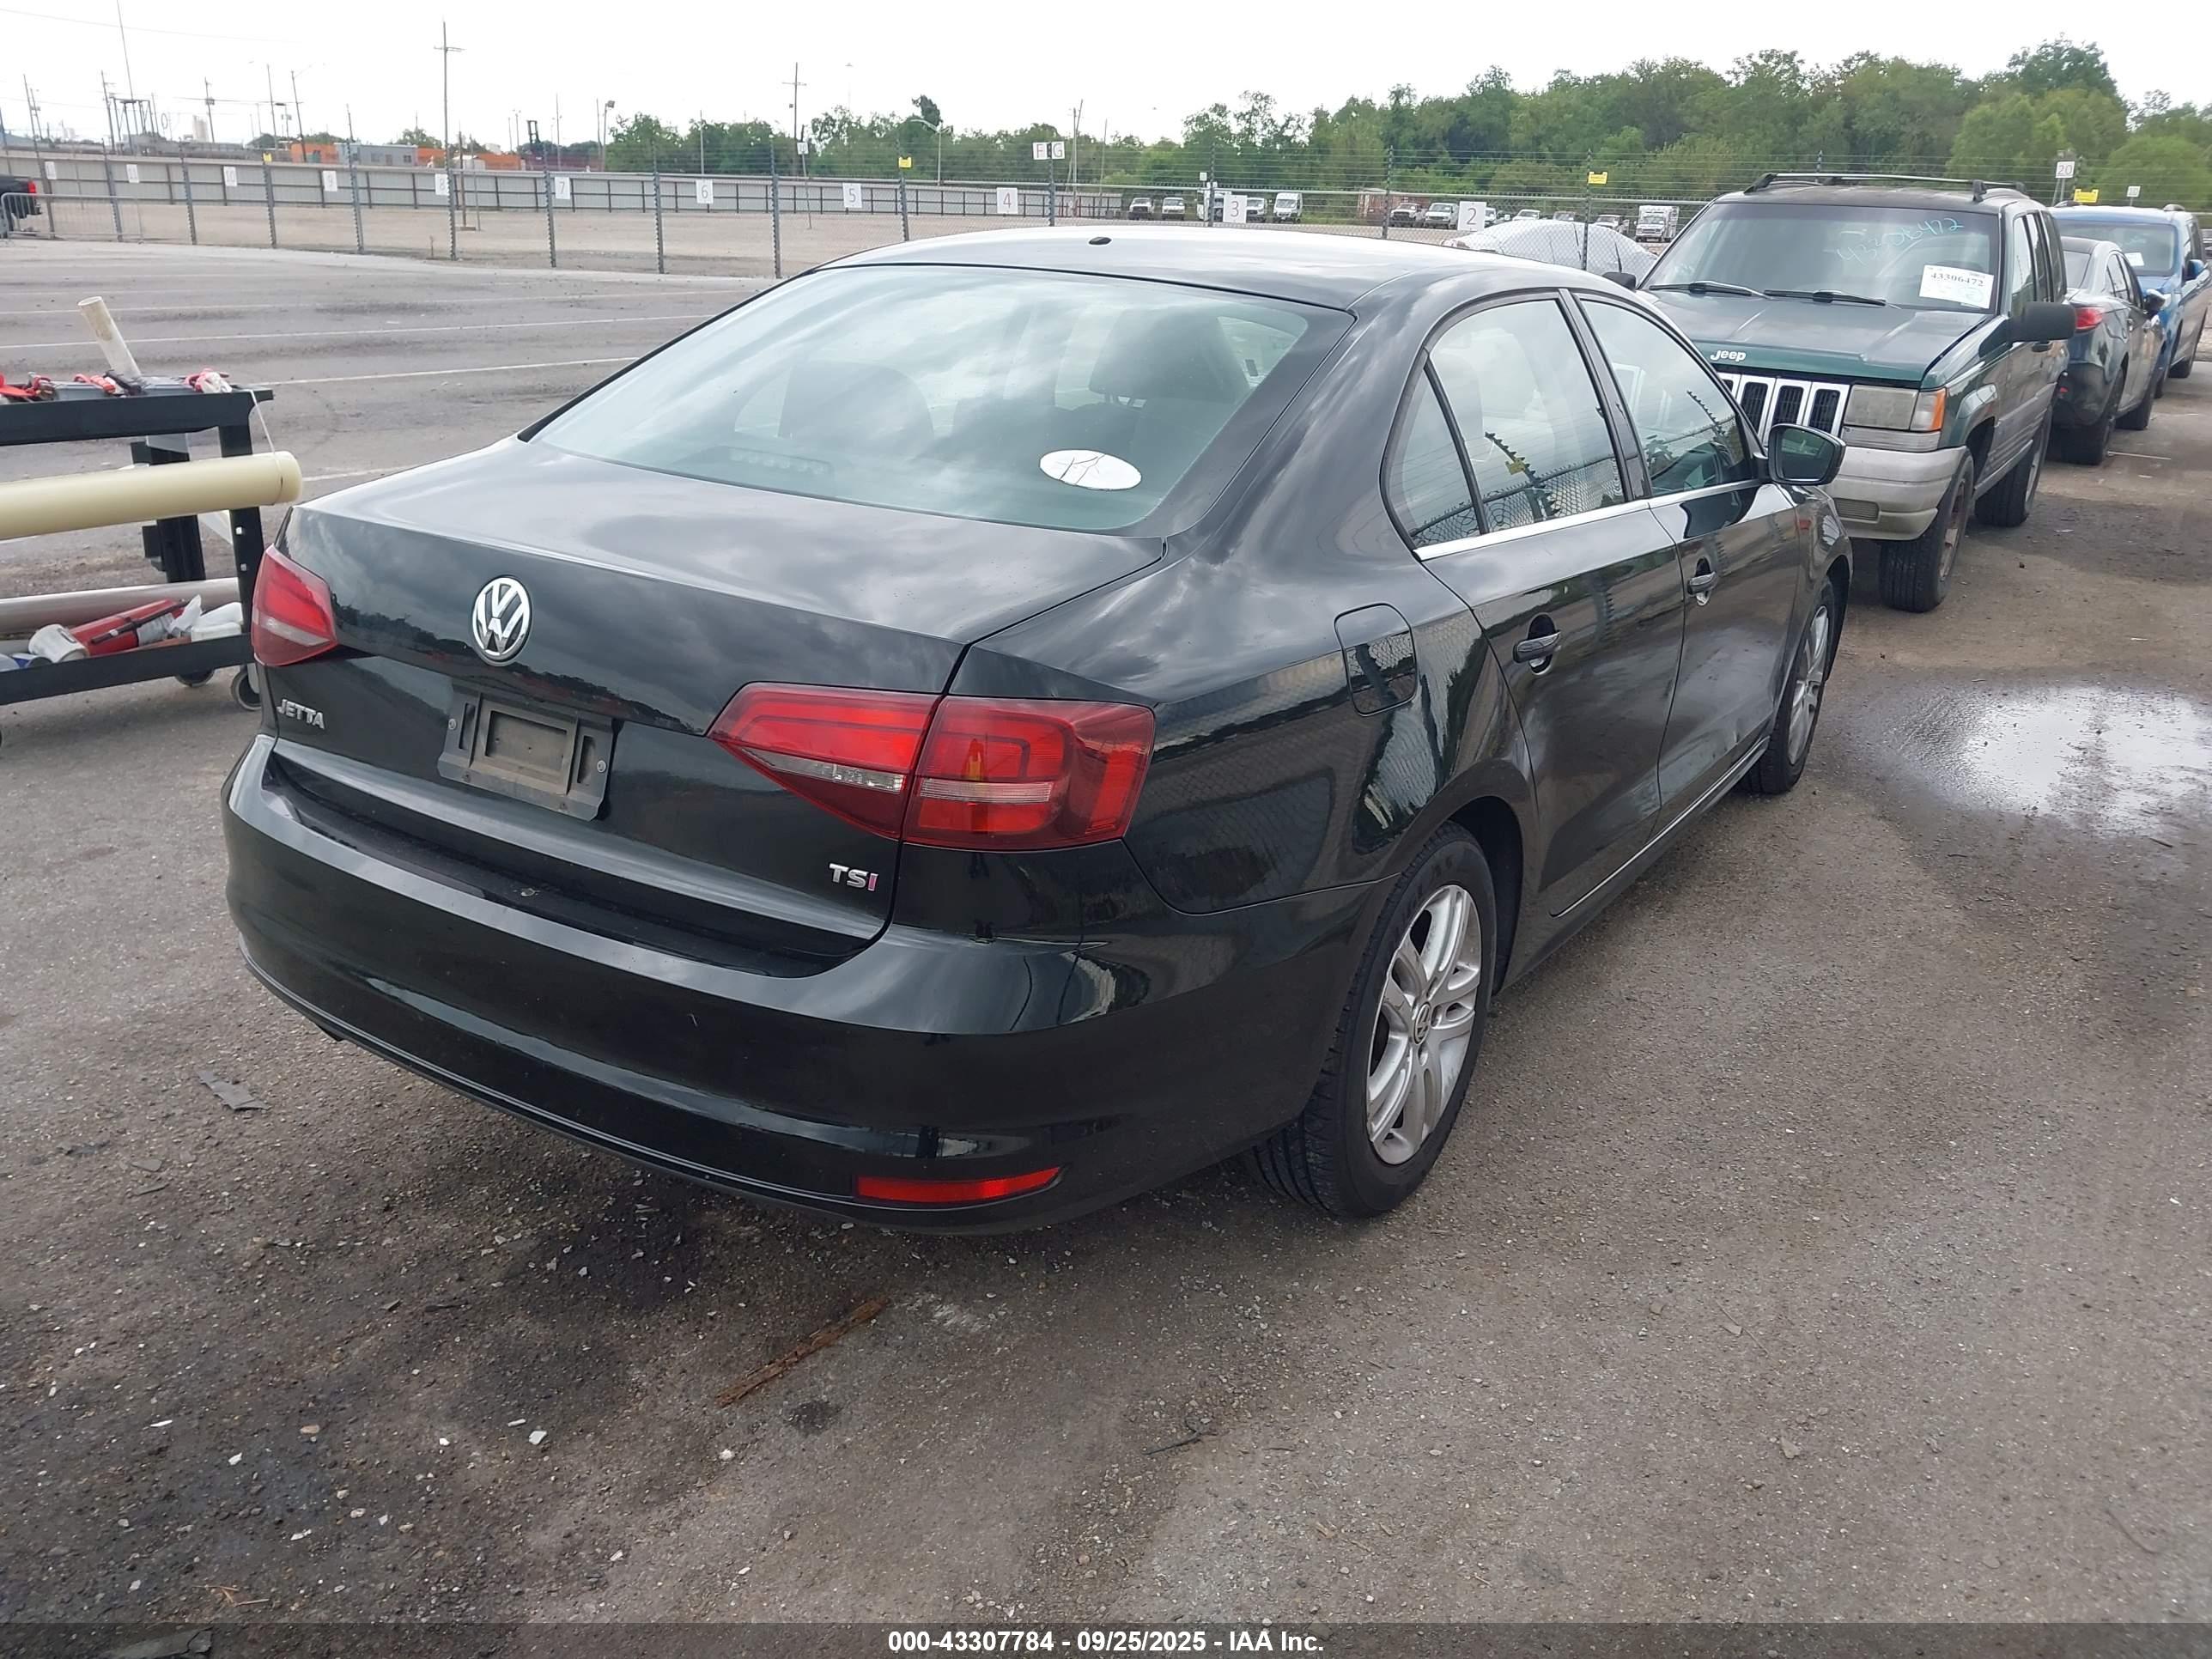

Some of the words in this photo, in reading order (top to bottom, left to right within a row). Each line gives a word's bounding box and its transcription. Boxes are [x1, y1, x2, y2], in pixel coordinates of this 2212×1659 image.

[1036, 143, 1044, 159] F
[1053, 143, 1064, 158] G
[2057, 164, 2073, 175] 20
[439, 177, 447, 191] 8
[559, 180, 567, 194] 7
[701, 185, 708, 199] 6
[848, 187, 857, 204] 5
[1003, 192, 1012, 209] 4
[1230, 200, 1239, 217] 3
[1467, 207, 1477, 225] 2
[1930, 272, 1986, 288] 43306472
[1710, 349, 1747, 362] Jeep
[276, 698, 325, 730] JETTA
[829, 863, 879, 891] TSI
